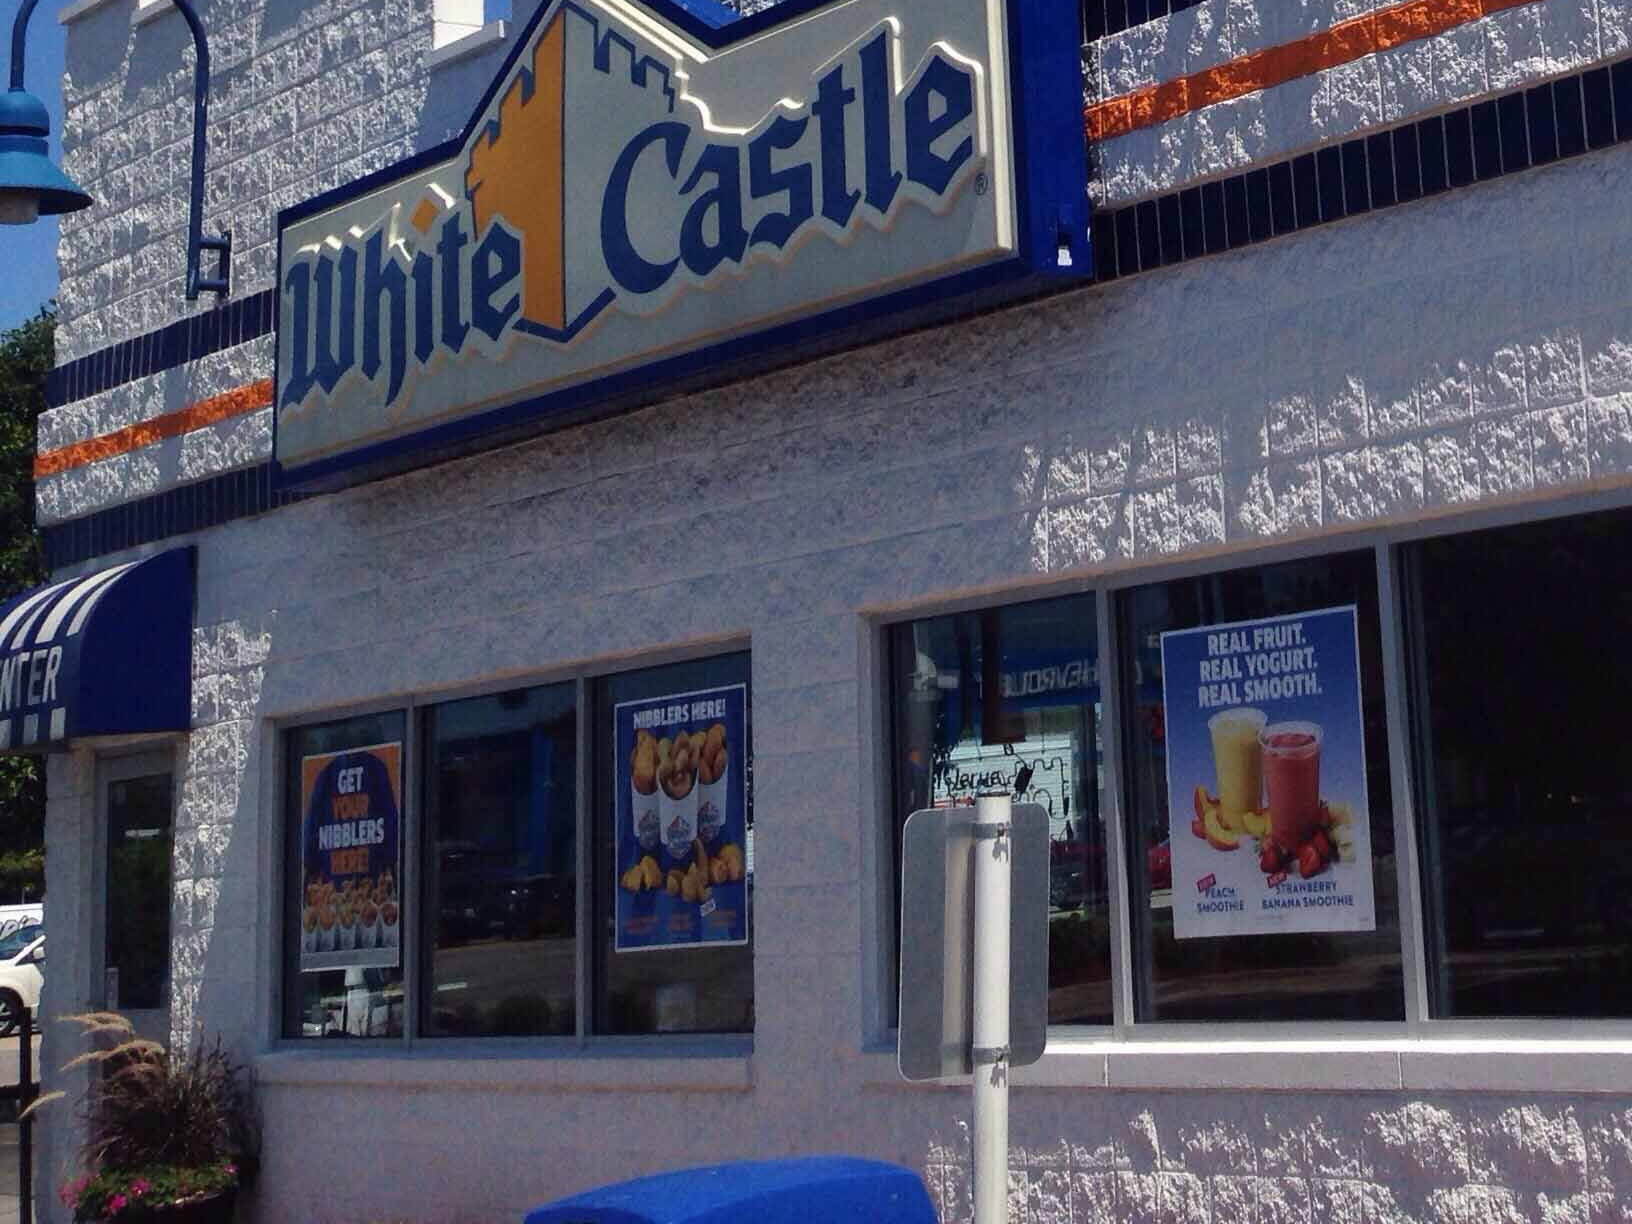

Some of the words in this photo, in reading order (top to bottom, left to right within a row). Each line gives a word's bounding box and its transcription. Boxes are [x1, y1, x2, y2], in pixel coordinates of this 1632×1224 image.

[281, 200, 522, 407] White
[600, 30, 978, 295] Castle
[1207, 631, 1251, 656] REAL
[1253, 623, 1306, 650] FRUIT.
[0, 645, 62, 712] NTER
[1199, 658, 1242, 682] REAL
[1245, 646, 1318, 677] YOGURT.
[1198, 682, 1241, 708] REAL
[1243, 672, 1322, 703] SMOOTH.
[633, 703, 689, 729] NIBBLERS
[691, 698, 726, 721] HERE!
[337, 766, 364, 794] GET
[319, 818, 385, 850] NIBBLERS
[1276, 880, 1337, 895] STRAWBERRY
[1302, 894, 1354, 907] SMOOTHIE
[1197, 900, 1245, 913] SMOOTHIE
